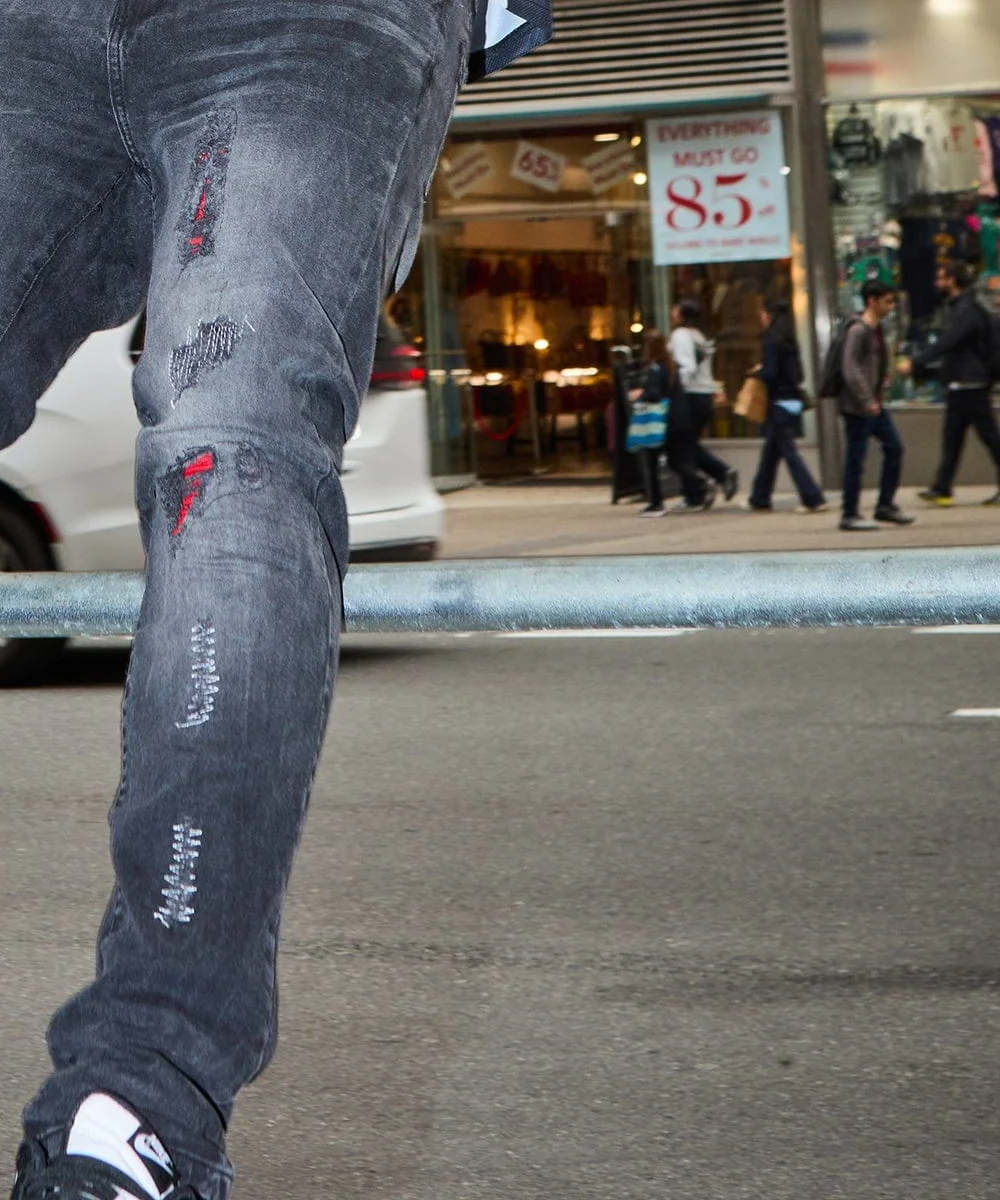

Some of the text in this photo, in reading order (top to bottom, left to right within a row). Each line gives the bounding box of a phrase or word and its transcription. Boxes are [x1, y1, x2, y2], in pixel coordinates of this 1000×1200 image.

[657, 117, 771, 142] EVERYTHING
[673, 146, 759, 167] MUST GO
[665, 173, 753, 233] 85
